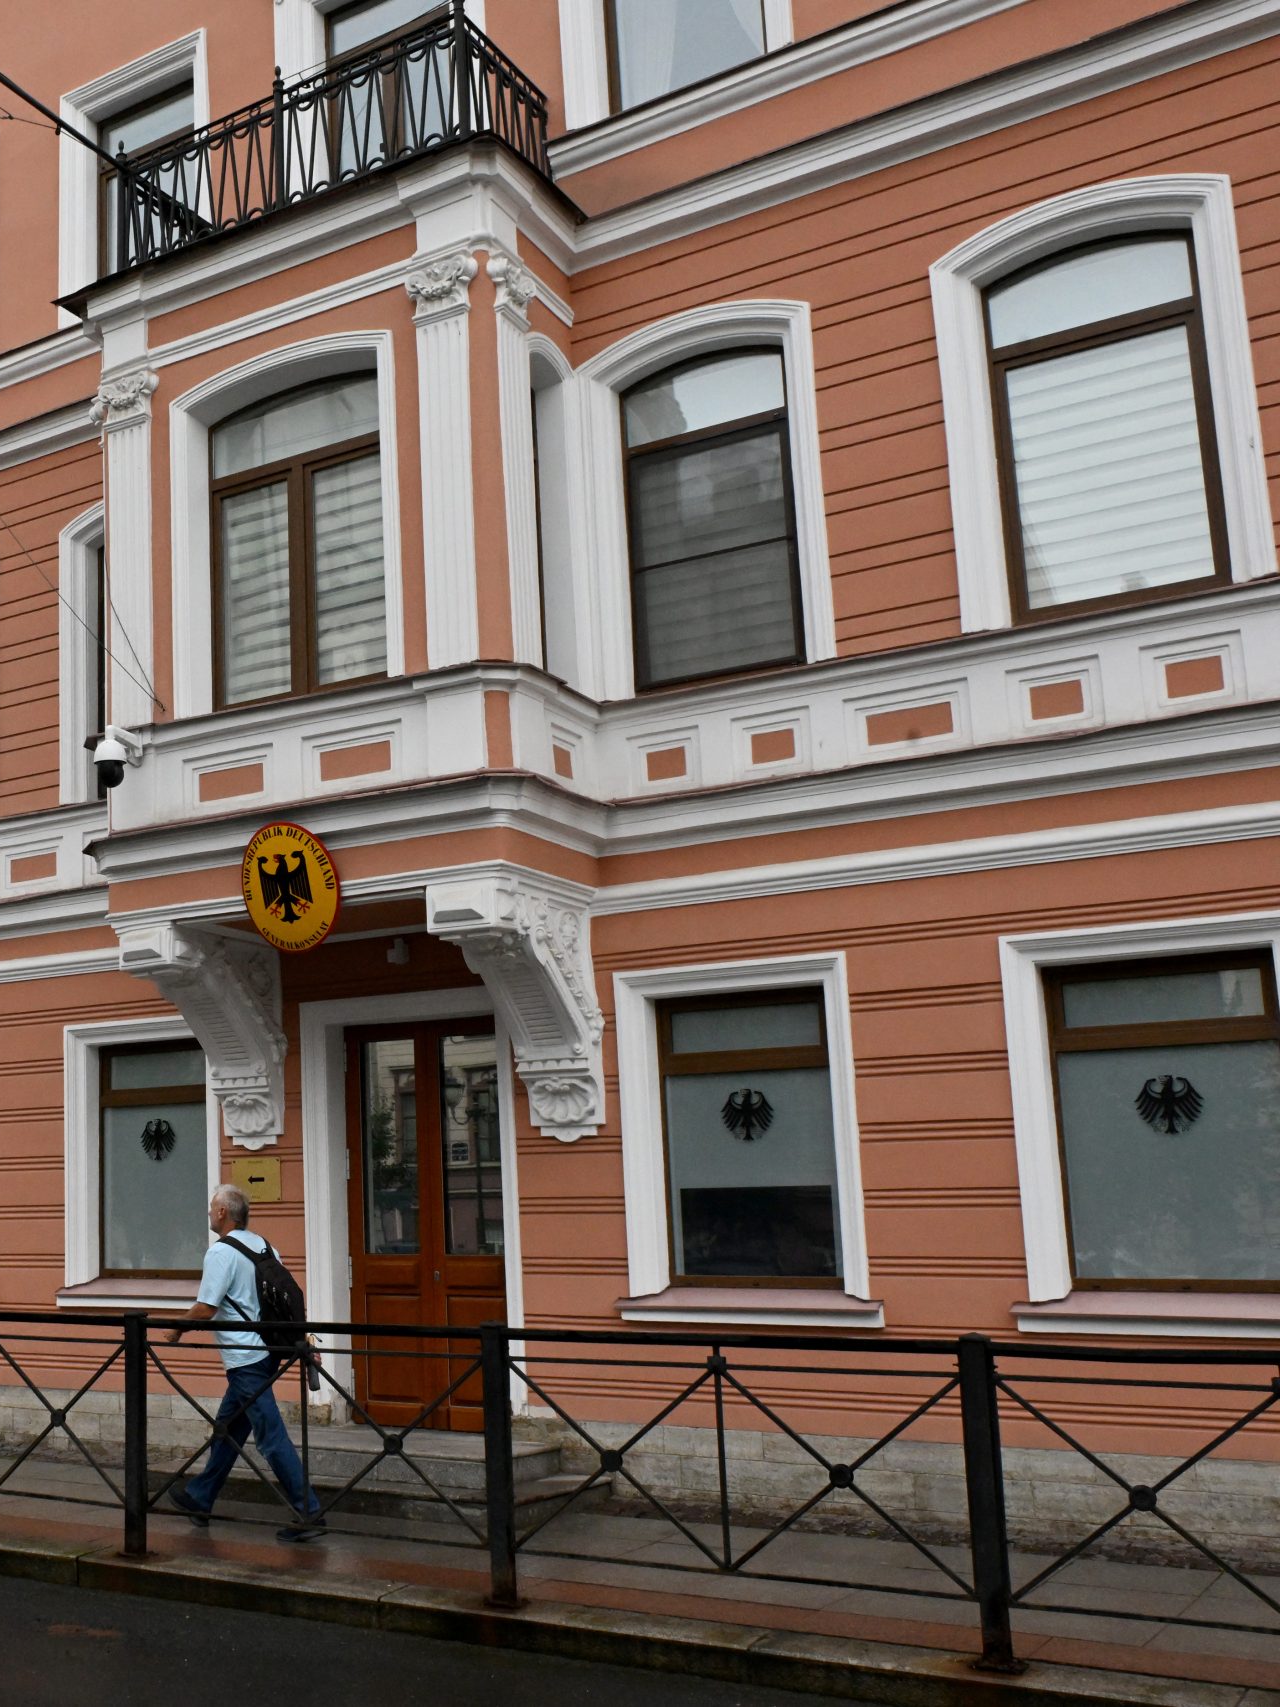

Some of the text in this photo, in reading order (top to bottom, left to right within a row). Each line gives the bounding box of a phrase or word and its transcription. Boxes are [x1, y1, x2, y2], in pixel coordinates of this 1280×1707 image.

[243, 826, 335, 901] BUNDESREPUBLIK DEUTSCHLAND
[261, 920, 329, 950] GENERALKONSULAT
